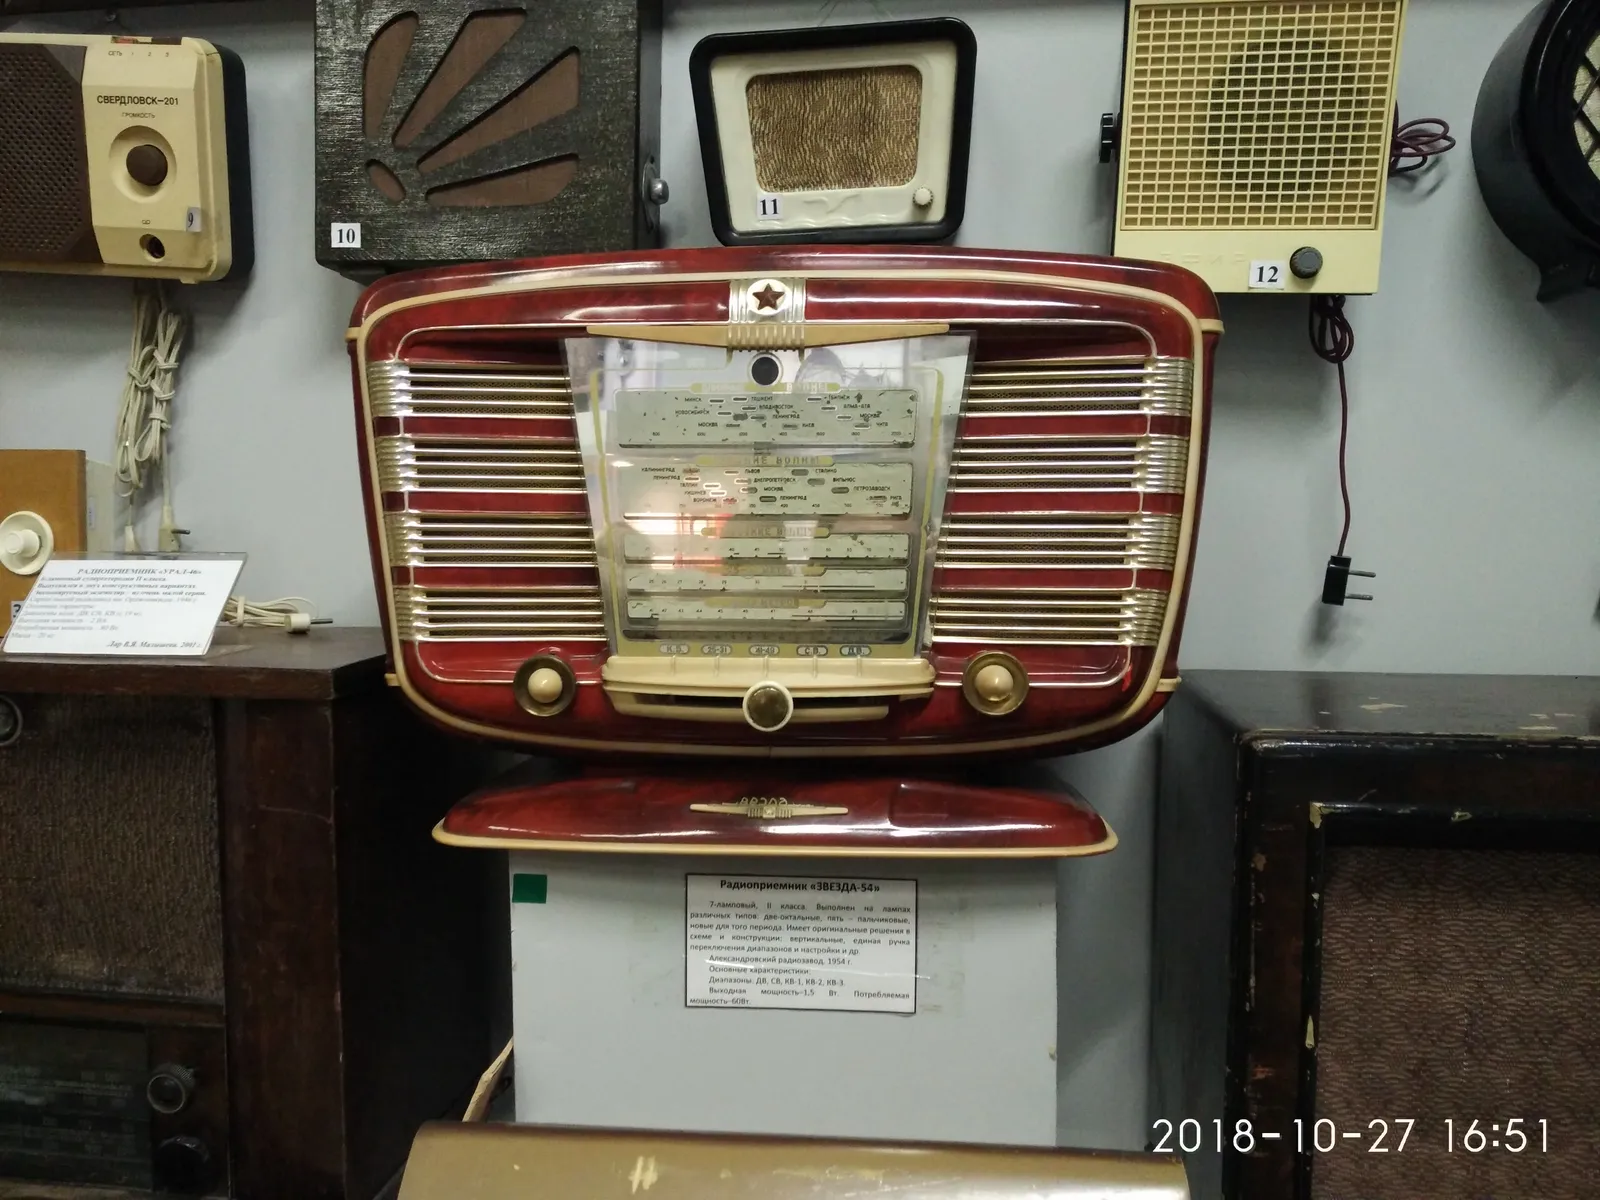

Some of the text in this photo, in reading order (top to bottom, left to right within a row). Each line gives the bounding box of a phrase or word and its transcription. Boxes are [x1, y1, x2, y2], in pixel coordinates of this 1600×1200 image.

[760, 198, 779, 215] 11
[188, 212, 194, 228] 9
[337, 228, 356, 244] 10
[1256, 266, 1278, 283] 12
[720, 880, 880, 894] Радиоприемник «ЗВЕЗДА-54»
[709, 901, 758, 910] 7-ламповый,
[858, 916, 910, 924] пальчиковые,
[790, 936, 845, 944] вертикальные,
[801, 946, 840, 954] настройки
[709, 955, 776, 963] Александровский
[709, 965, 747, 973] Основные
[854, 990, 910, 998] Потребляемая
